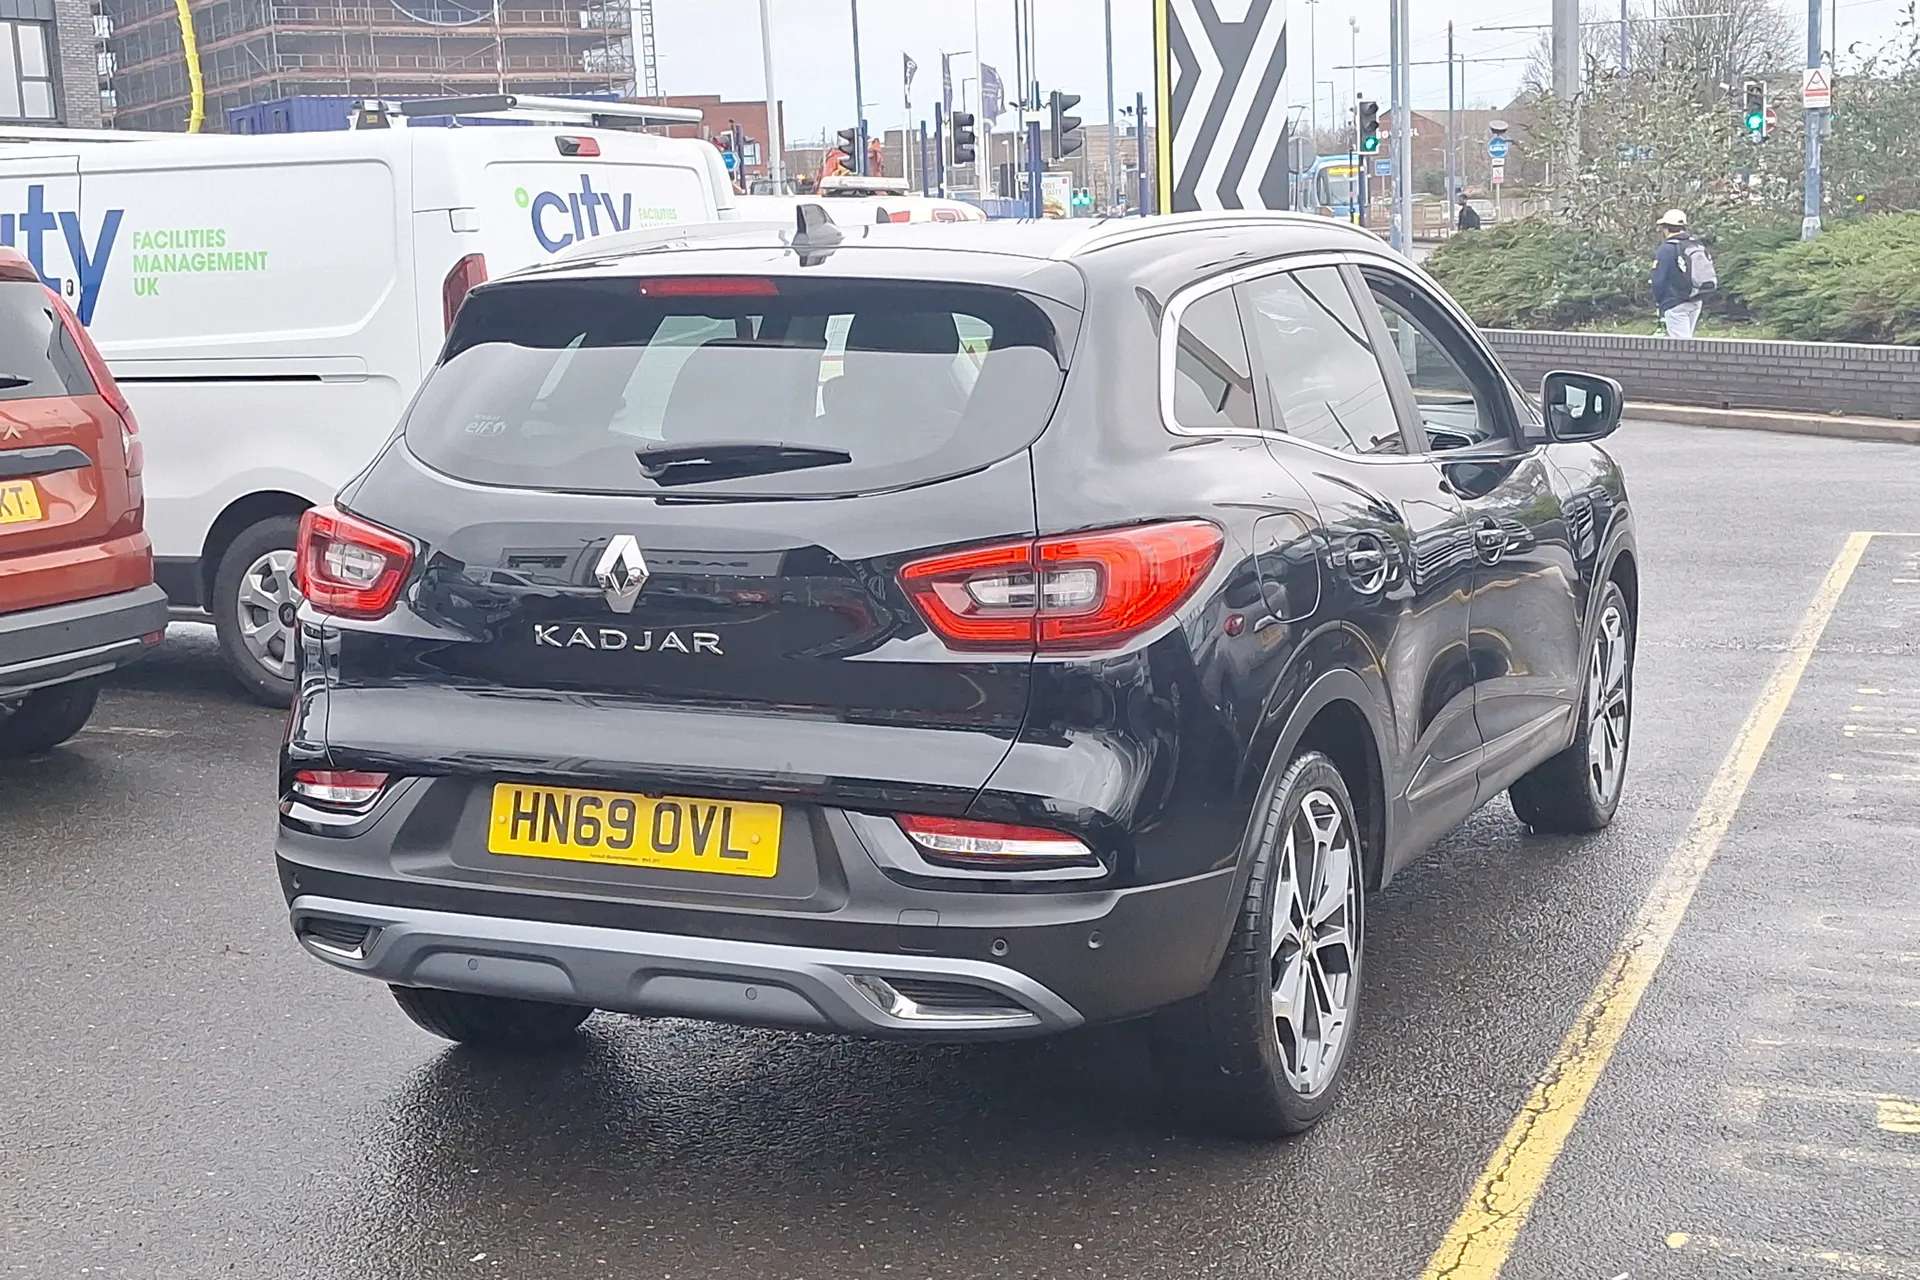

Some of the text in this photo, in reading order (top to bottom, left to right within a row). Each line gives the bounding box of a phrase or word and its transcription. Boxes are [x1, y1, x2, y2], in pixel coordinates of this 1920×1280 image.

[532, 174, 632, 254] city
[132, 229, 226, 250] FACILITIES
[132, 251, 268, 273] MANAGEMENT
[134, 277, 160, 297] UK
[534, 624, 724, 655] KADJAR
[510, 790, 749, 861] HN69 OVL
